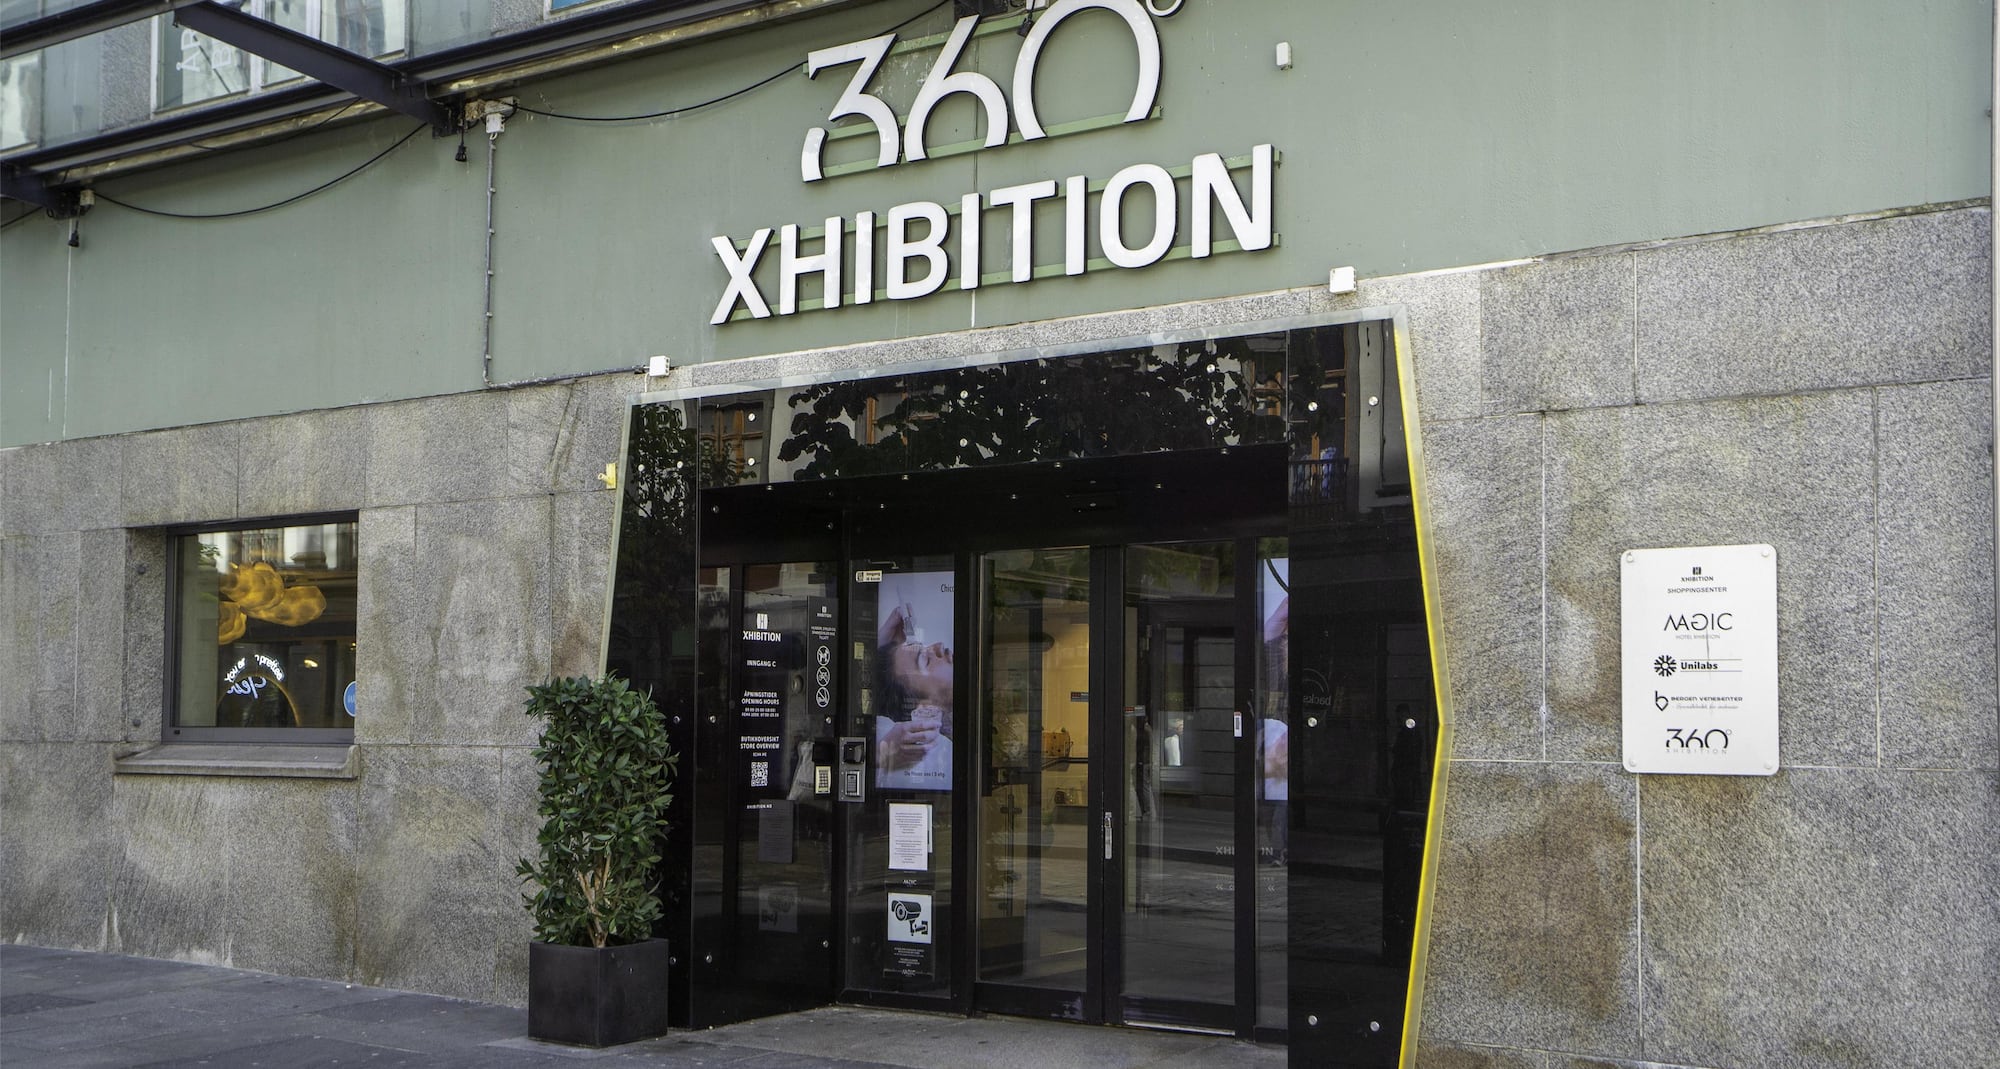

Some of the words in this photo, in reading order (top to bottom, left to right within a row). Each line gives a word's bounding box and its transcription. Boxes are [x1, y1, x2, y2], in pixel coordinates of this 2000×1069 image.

[709, 143, 1276, 326] XHIBITION
[1667, 586, 1728, 594] SHOPPINGSENTER
[1663, 612, 1733, 631] MAGIC
[742, 631, 781, 642] XHIBITION
[746, 659, 771, 667] INNGANG
[1680, 661, 1718, 670] Unilabs
